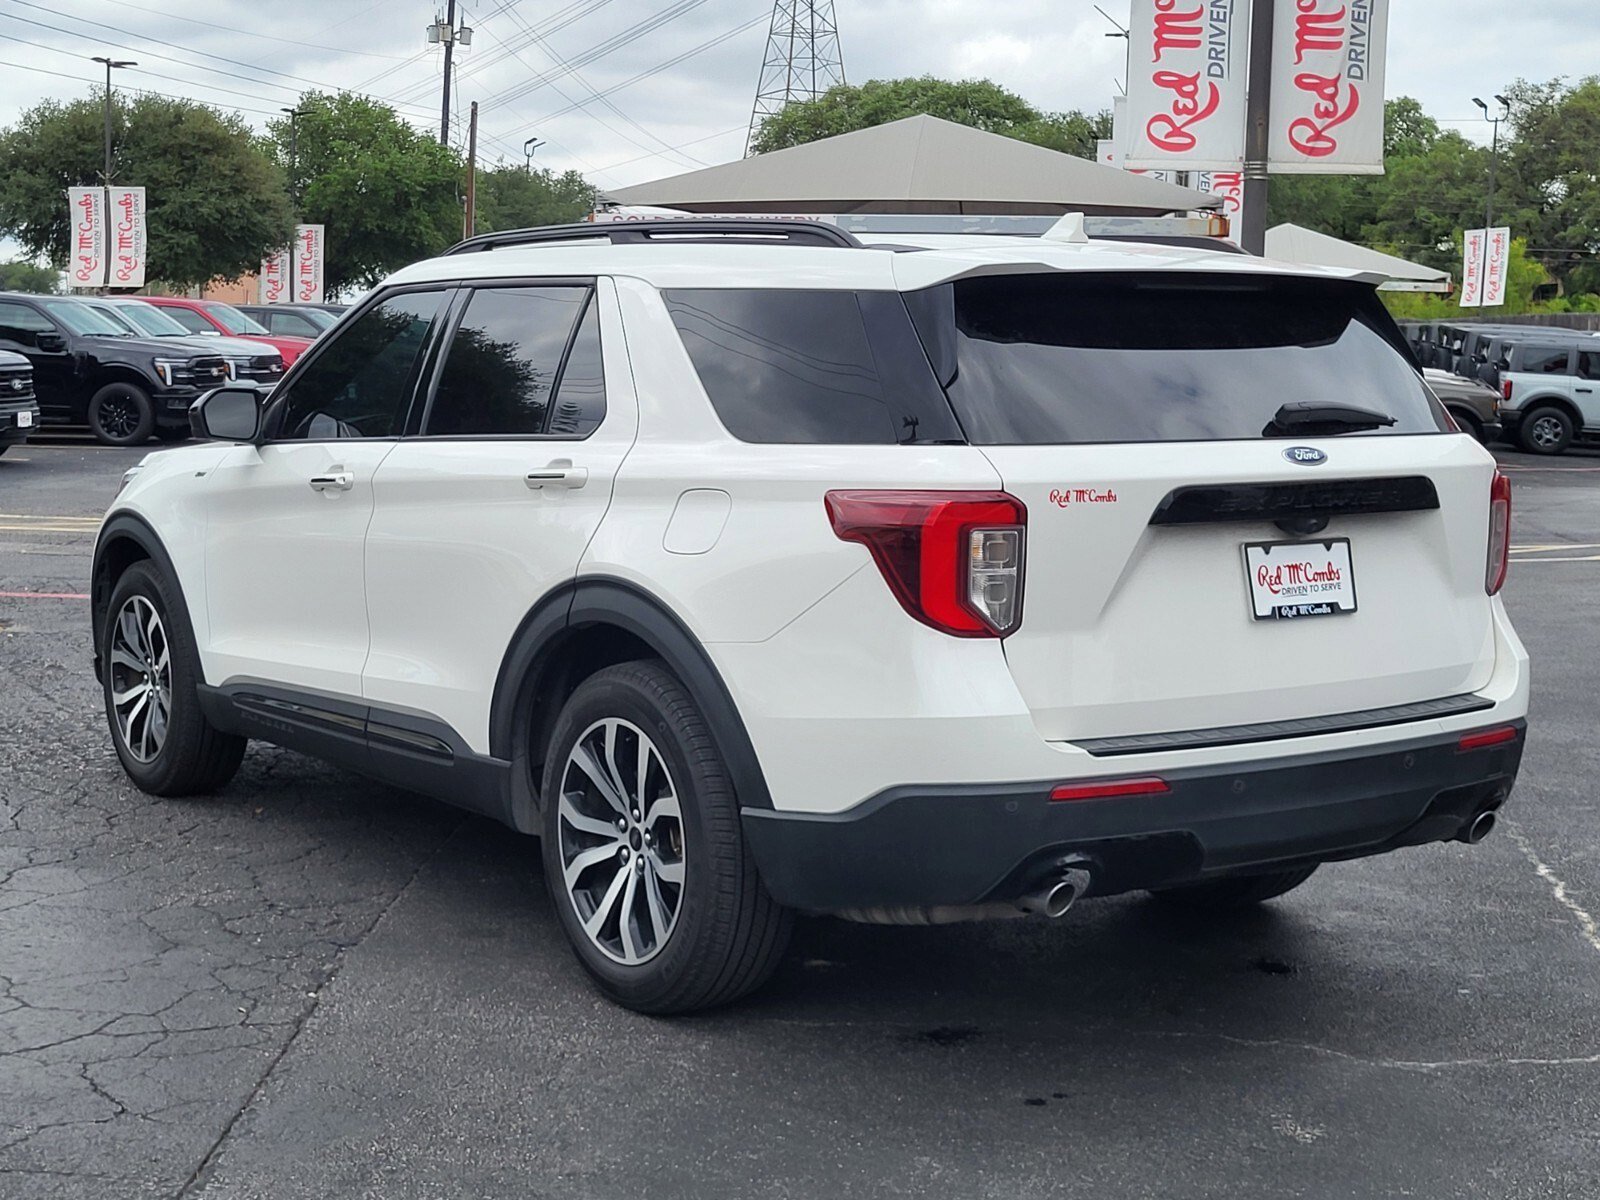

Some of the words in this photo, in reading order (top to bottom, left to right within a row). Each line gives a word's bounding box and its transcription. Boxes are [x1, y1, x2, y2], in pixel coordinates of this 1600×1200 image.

[1146, 71, 1220, 152] Red
[1288, 73, 1359, 158] Red
[78, 193, 93, 253] McCombs
[117, 193, 133, 253] McCombs
[300, 229, 313, 278] McCombs
[76, 255, 98, 281] Red
[116, 255, 138, 281] Red
[266, 279, 284, 300] Red
[299, 280, 317, 301] Red
[1294, 448, 1320, 461] Ford
[1049, 488, 1071, 508] Red
[1072, 488, 1117, 503] McCombs
[1257, 564, 1283, 595] Red
[1283, 561, 1341, 585] McCombs
[1281, 586, 1308, 597] DRIVEN
[1309, 584, 1320, 594] TO
[1320, 582, 1342, 592] SERVE
[1280, 605, 1297, 618] Red
[1298, 603, 1332, 615] McCombs
